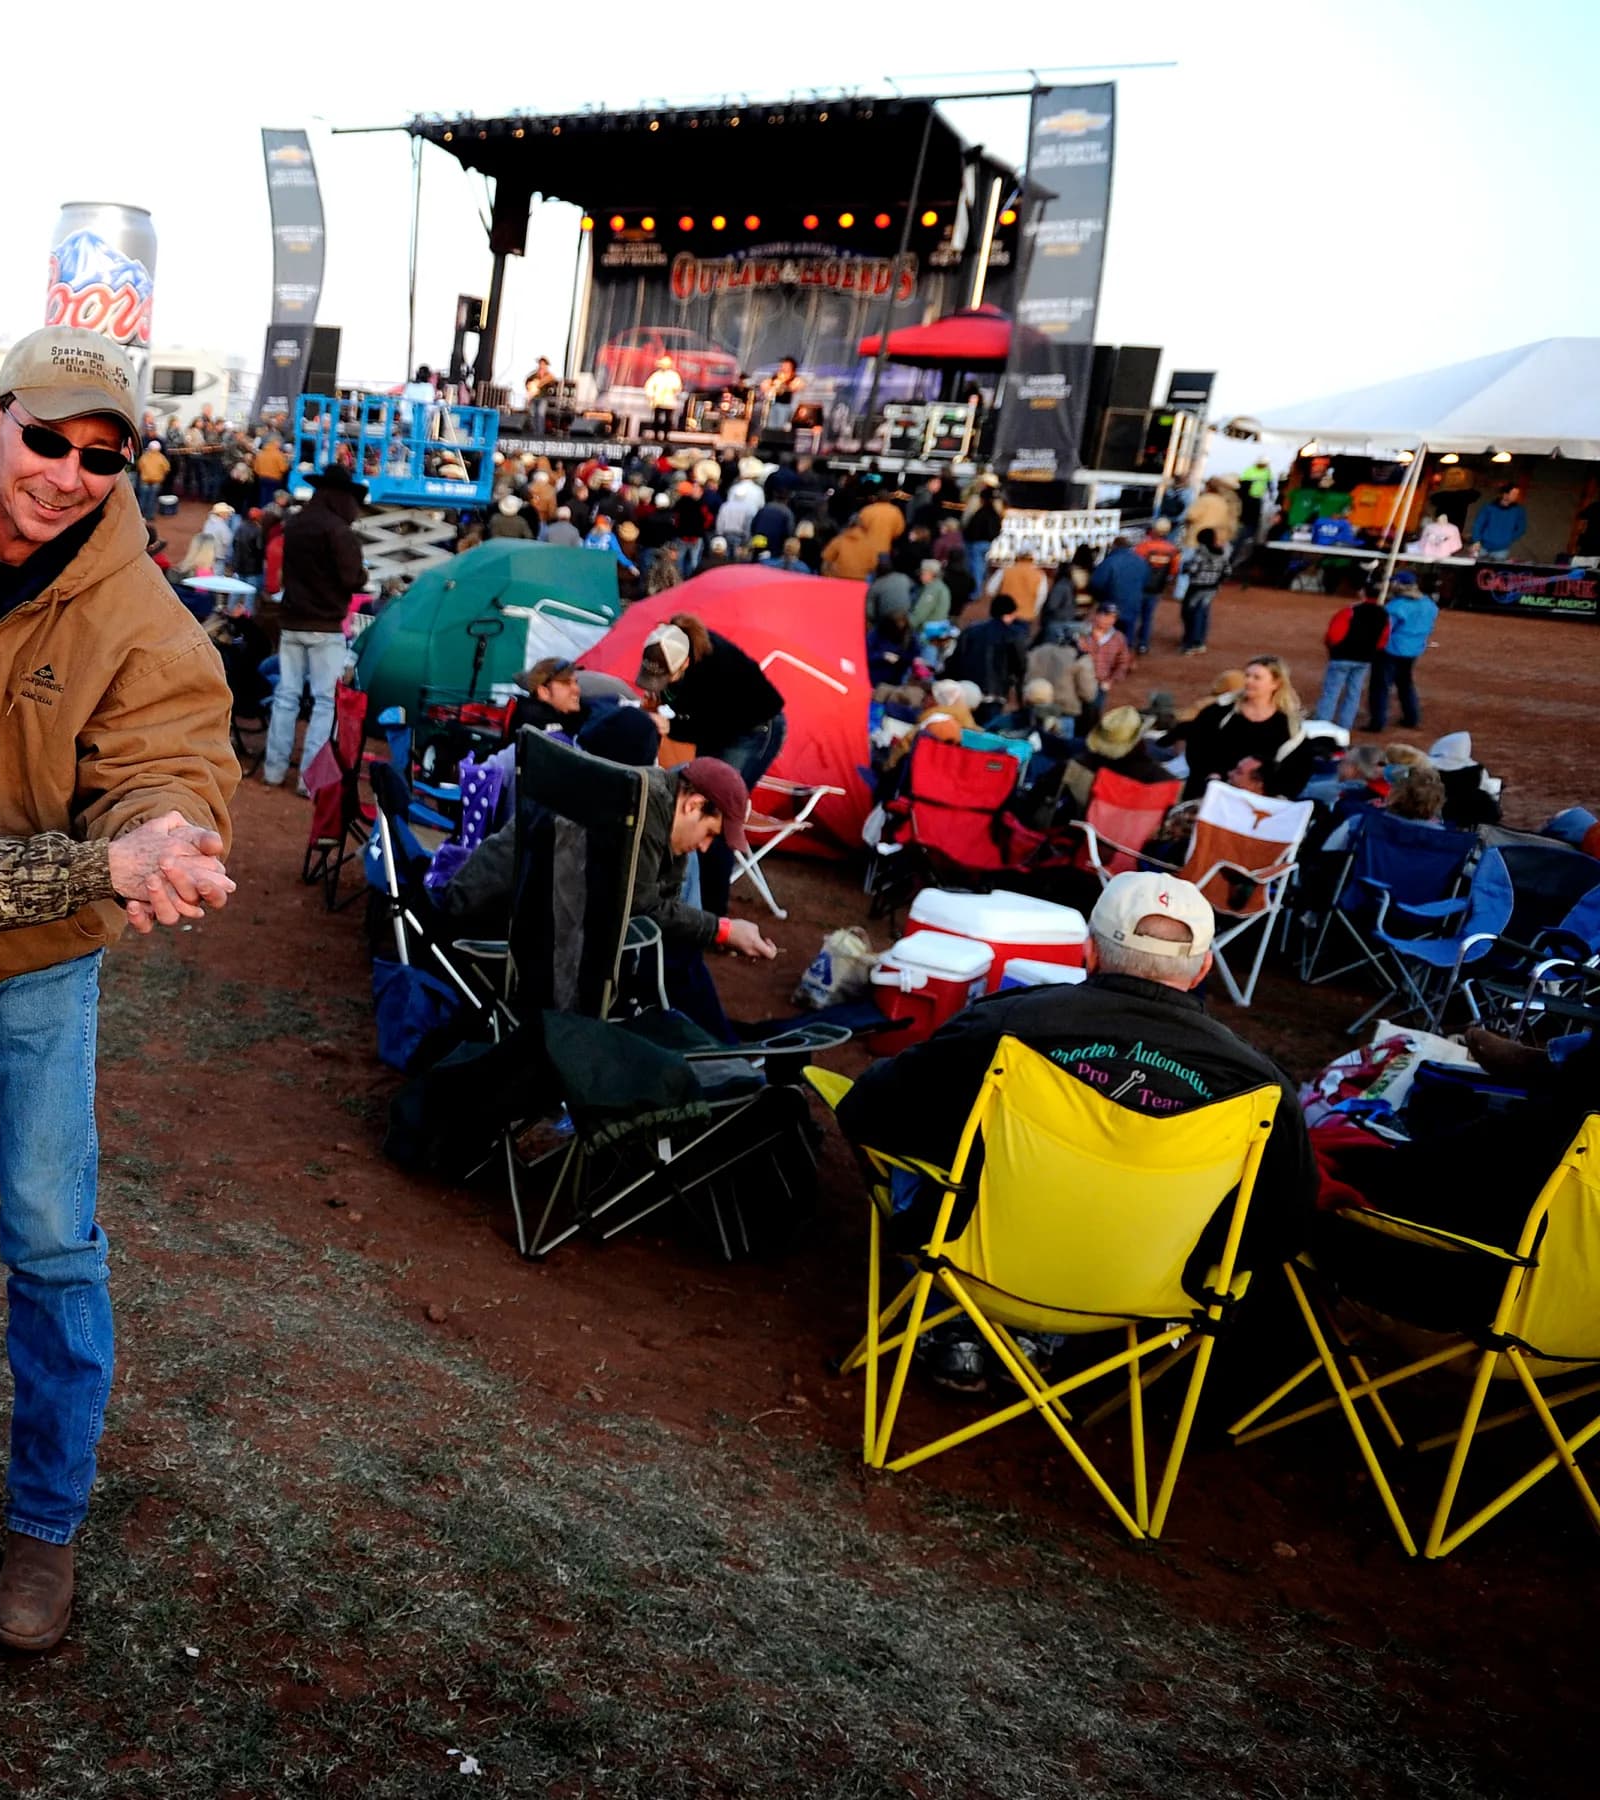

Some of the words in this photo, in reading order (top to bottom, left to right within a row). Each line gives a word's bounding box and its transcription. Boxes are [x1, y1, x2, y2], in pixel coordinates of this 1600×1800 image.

[670, 252, 779, 302] OUTLAWS
[51, 346, 105, 361] Sparkman
[1077, 1062, 1109, 1085] Pro
